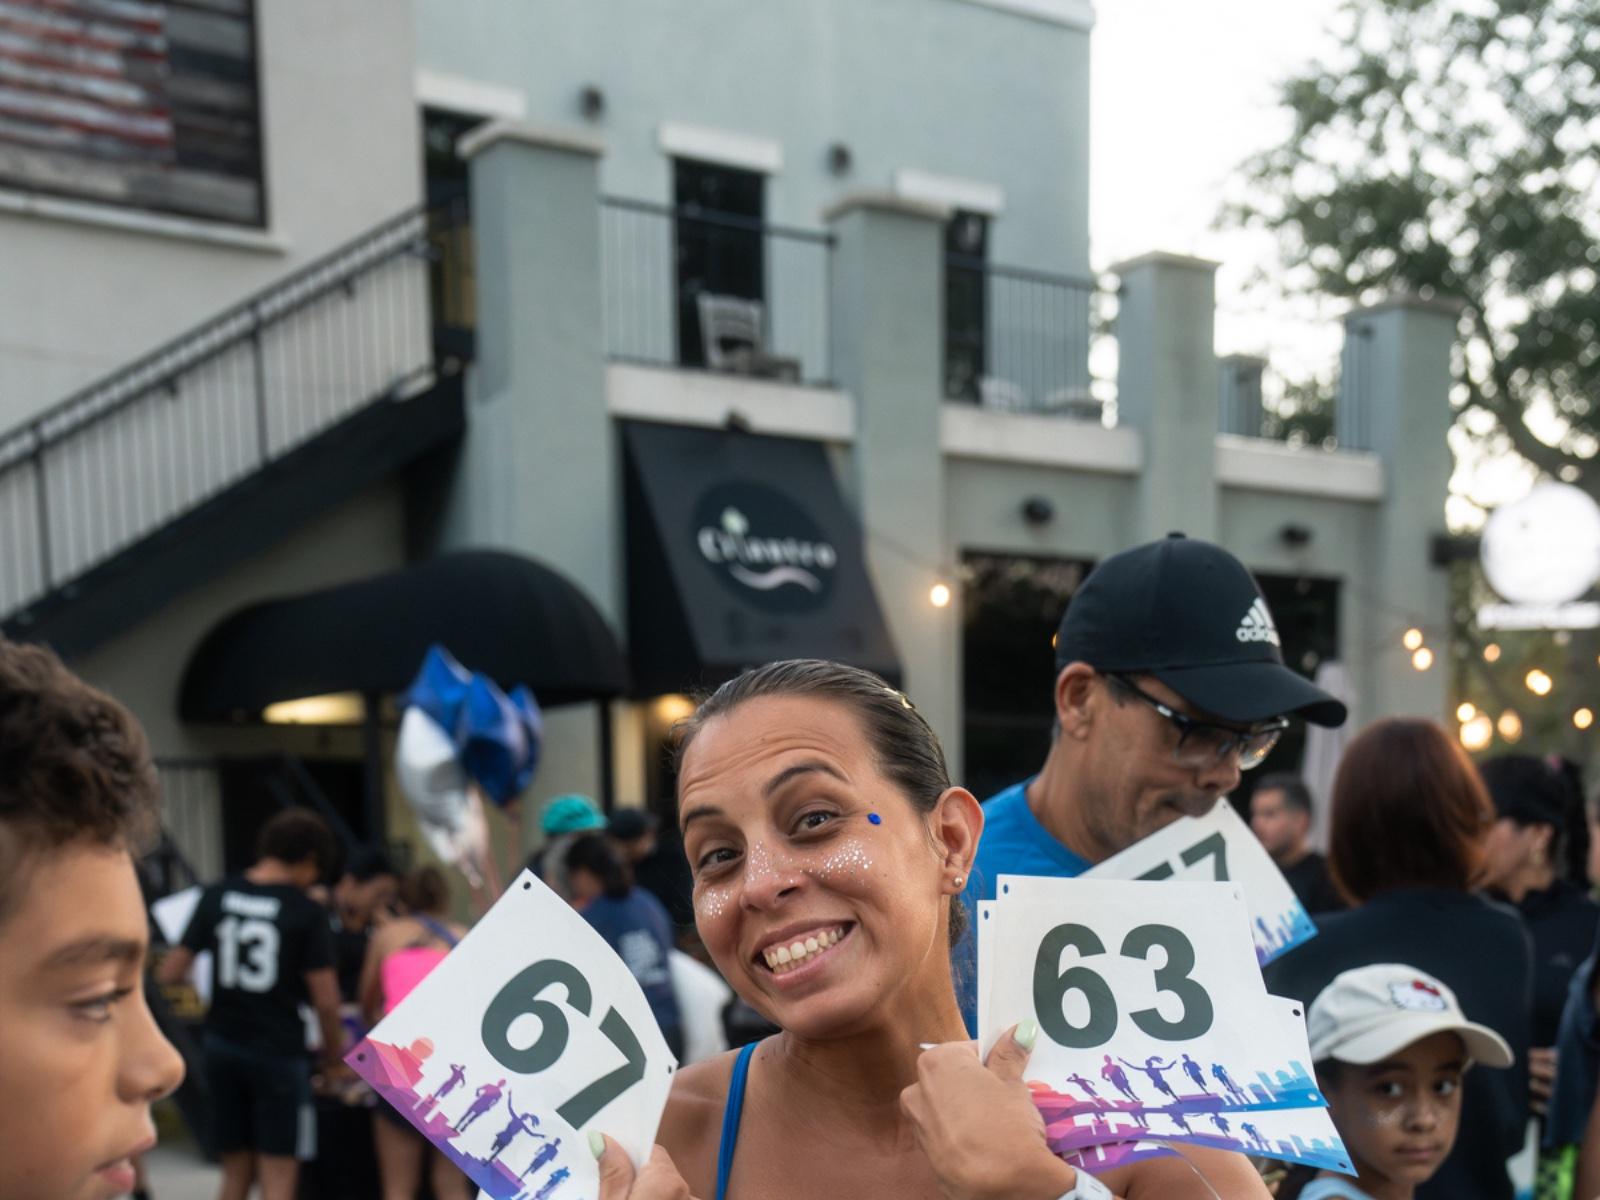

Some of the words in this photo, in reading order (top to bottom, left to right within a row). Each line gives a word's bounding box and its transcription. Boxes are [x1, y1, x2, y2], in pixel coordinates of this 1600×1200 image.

[1236, 624, 1280, 647] adid
[1132, 831, 1230, 882] 7
[215, 914, 280, 992] 13
[1032, 922, 1214, 1049] 63
[480, 958, 648, 1131] 67
